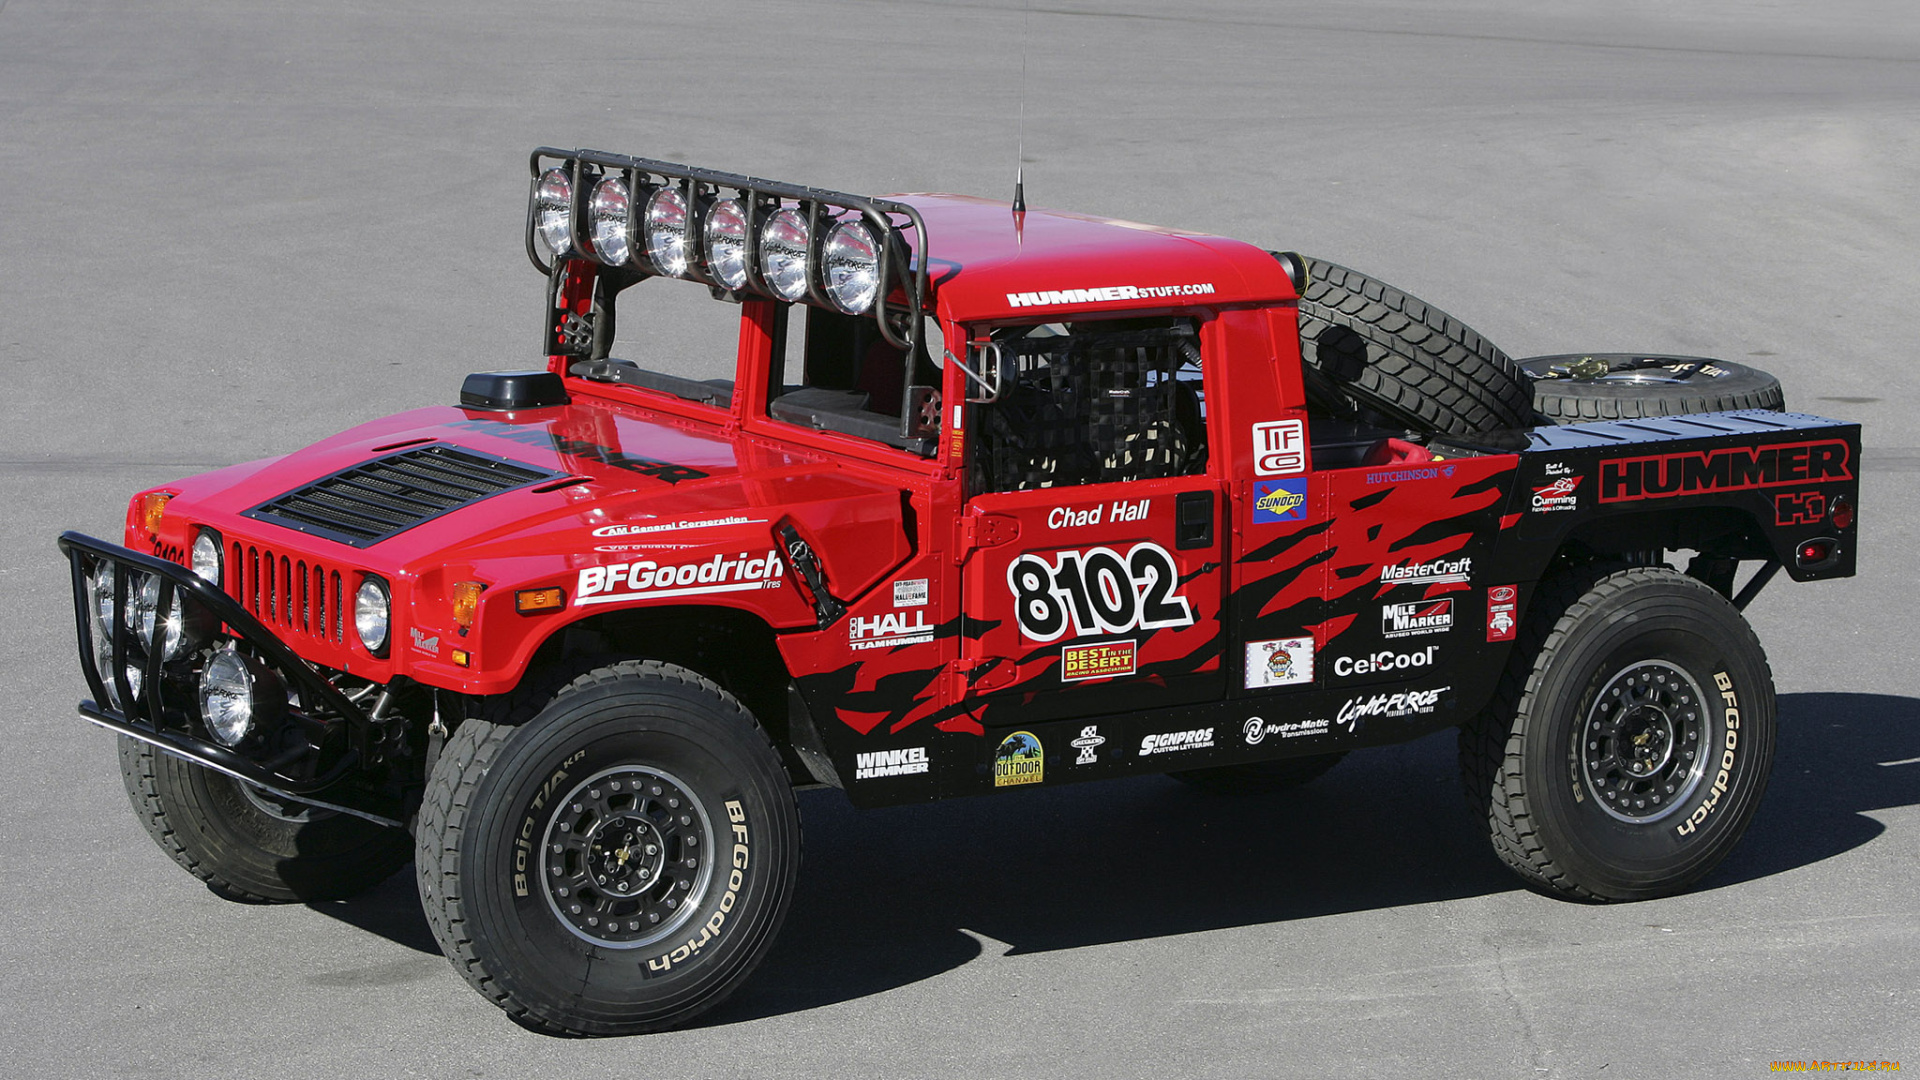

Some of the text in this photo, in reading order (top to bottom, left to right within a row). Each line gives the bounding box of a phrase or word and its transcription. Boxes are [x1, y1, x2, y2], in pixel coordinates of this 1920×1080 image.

[1366, 467, 1439, 484] HUTCHINSON
[1598, 438, 1854, 504] HUMMER
[1259, 495, 1301, 508] SUNOCO
[1532, 495, 1577, 507] Cumming
[1775, 491, 1826, 527] H1
[1047, 499, 1151, 530] Chad Hall
[607, 516, 748, 536] AM General Corporation
[577, 550, 784, 598] BFGoodrich
[1380, 557, 1472, 580] MasterCraft
[761, 579, 782, 590] Tires
[1007, 542, 1194, 642] 8102
[1382, 604, 1416, 620] MILE
[849, 610, 935, 639] ROD HALL
[1393, 613, 1451, 631] MARKER
[1384, 631, 1410, 639] ABUSED
[1410, 629, 1433, 637] WORLD
[1066, 647, 1110, 661] BEST
[1066, 655, 1132, 671] DESERT
[1066, 666, 1132, 677] RACING ASSOCIATION
[1266, 718, 1330, 734] Hydra-Matic
[1281, 727, 1329, 739] Transmissions
[1138, 727, 1215, 757] SIGNPROS
[1153, 740, 1215, 754] CUSTOM LETTERING
[856, 747, 929, 769] WINKEL
[1677, 671, 1740, 836] BFGoodrich
[856, 762, 929, 780] HUMMER
[996, 760, 1041, 777] OUTDOOR
[996, 774, 1041, 786] CHANNEL
[514, 749, 586, 897] Baja T/A KR
[648, 799, 750, 973] BFGoodrich
